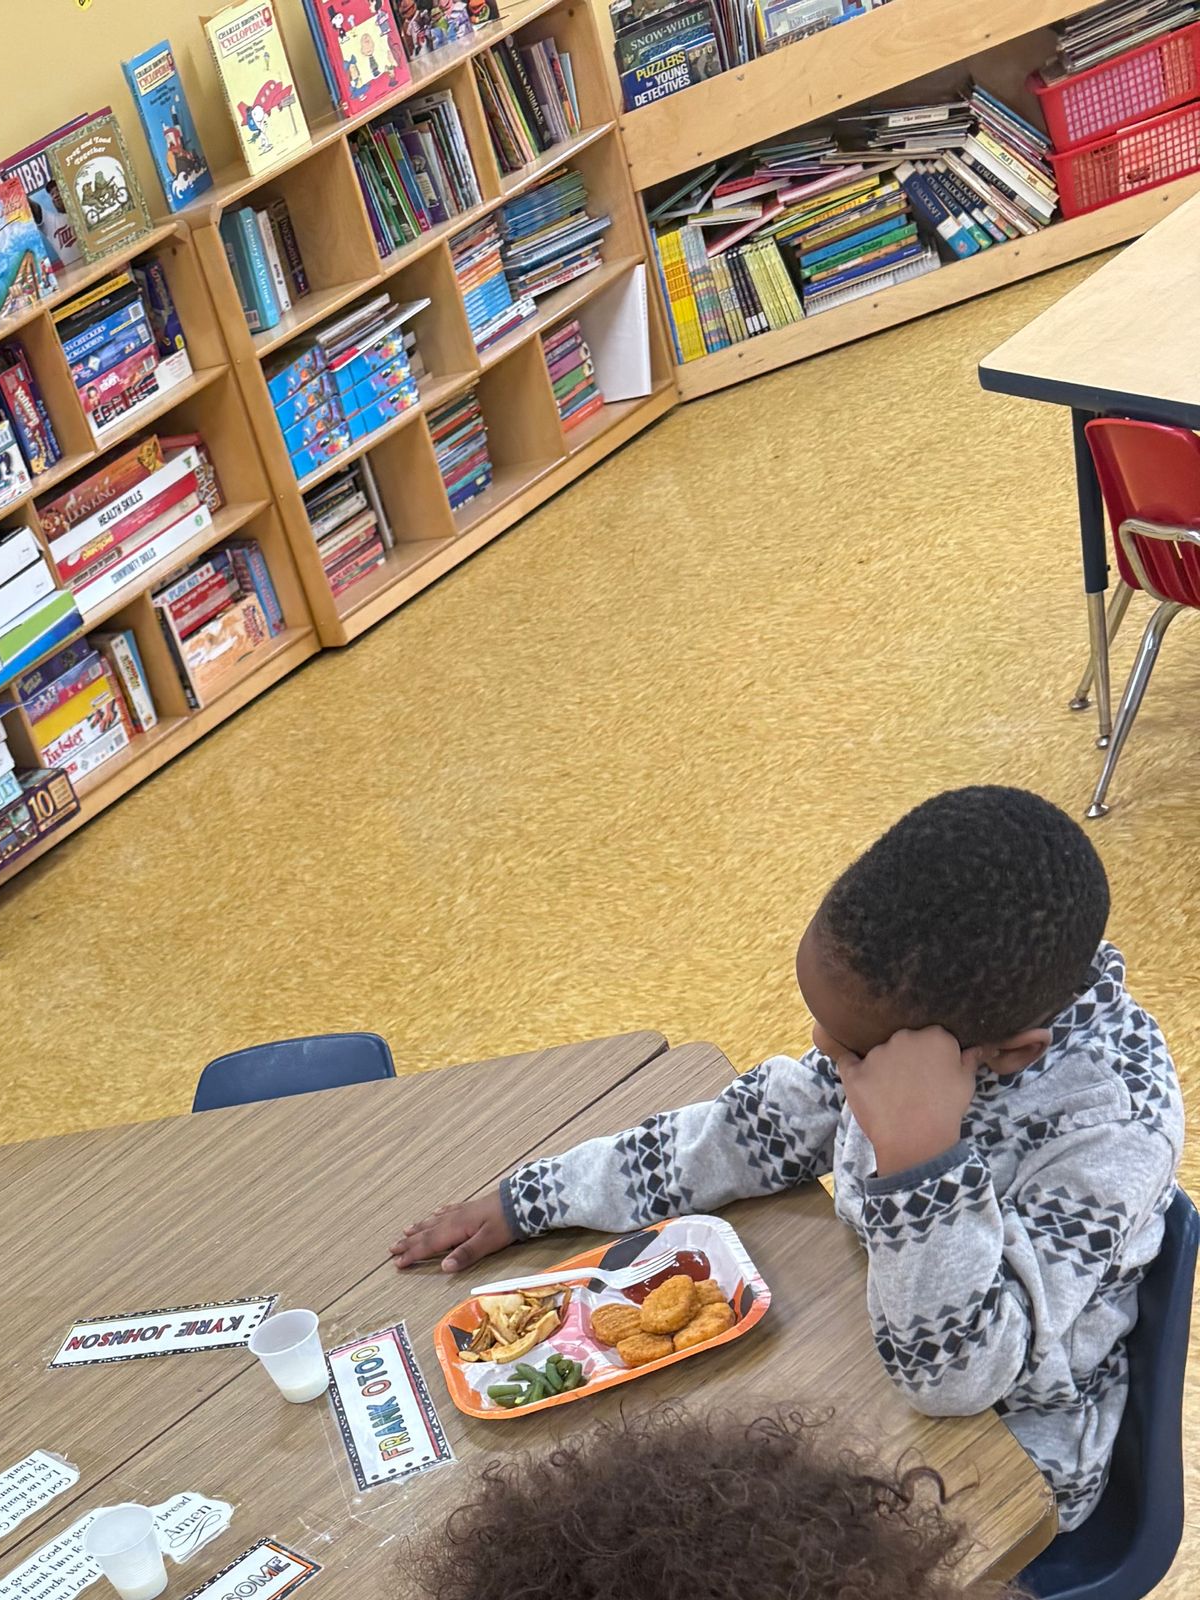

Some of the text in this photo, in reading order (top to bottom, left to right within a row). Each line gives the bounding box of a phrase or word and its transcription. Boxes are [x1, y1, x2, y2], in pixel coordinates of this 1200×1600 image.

[630, 12, 705, 51] SNOW-WHITE
[636, 51, 685, 82] PUZZLERS
[654, 63, 689, 85] YOUNG
[634, 74, 691, 107] DETECTIVES
[911, 181, 942, 220] CHILDCRAFT
[98, 490, 143, 527] HEALTH SKILLS
[42, 727, 83, 769] Twister
[28, 789, 54, 821] 10
[65, 1315, 245, 1352] KYRIE JOHNSON
[350, 1344, 416, 1462] FRANK OTOO
[4, 1459, 36, 1478] Thank
[18, 1473, 34, 1483] his
[42, 1470, 60, 1481] Let
[28, 1482, 40, 1491] us
[48, 1478, 70, 1494] God
[0, 1492, 27, 1512] thank
[11, 1499, 37, 1520] great
[157, 1496, 191, 1520] bread
[165, 1506, 211, 1537] Amen
[11, 1565, 38, 1586] great
[39, 1545, 62, 1562] God
[20, 1573, 51, 1594] thank
[49, 1555, 73, 1570] him
[67, 1563, 82, 1574] we
[68, 1569, 96, 1591] Lord
